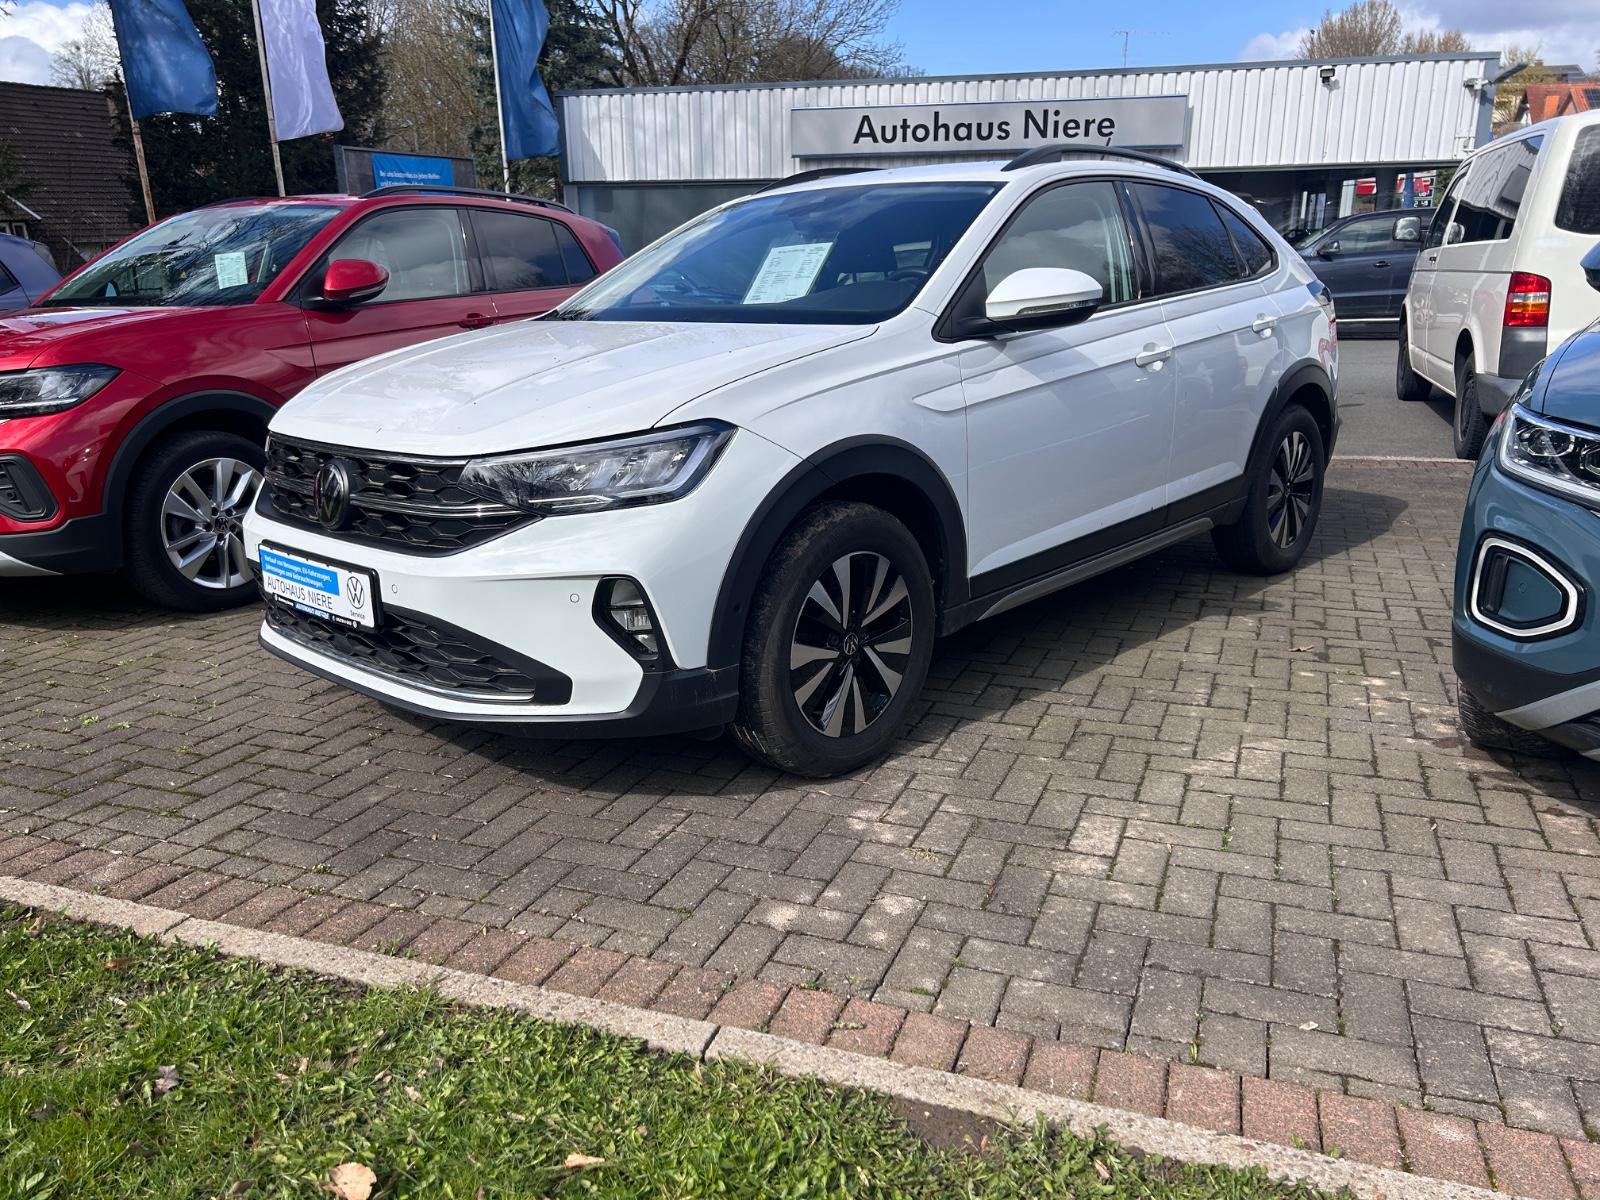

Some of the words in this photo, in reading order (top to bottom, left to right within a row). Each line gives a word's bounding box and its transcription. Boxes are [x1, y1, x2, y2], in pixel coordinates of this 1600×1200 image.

[853, 111, 1011, 144] Autohaus
[1024, 108, 1115, 140] Niere
[267, 576, 306, 600] AUTOHAUS
[308, 591, 333, 610] NIERE
